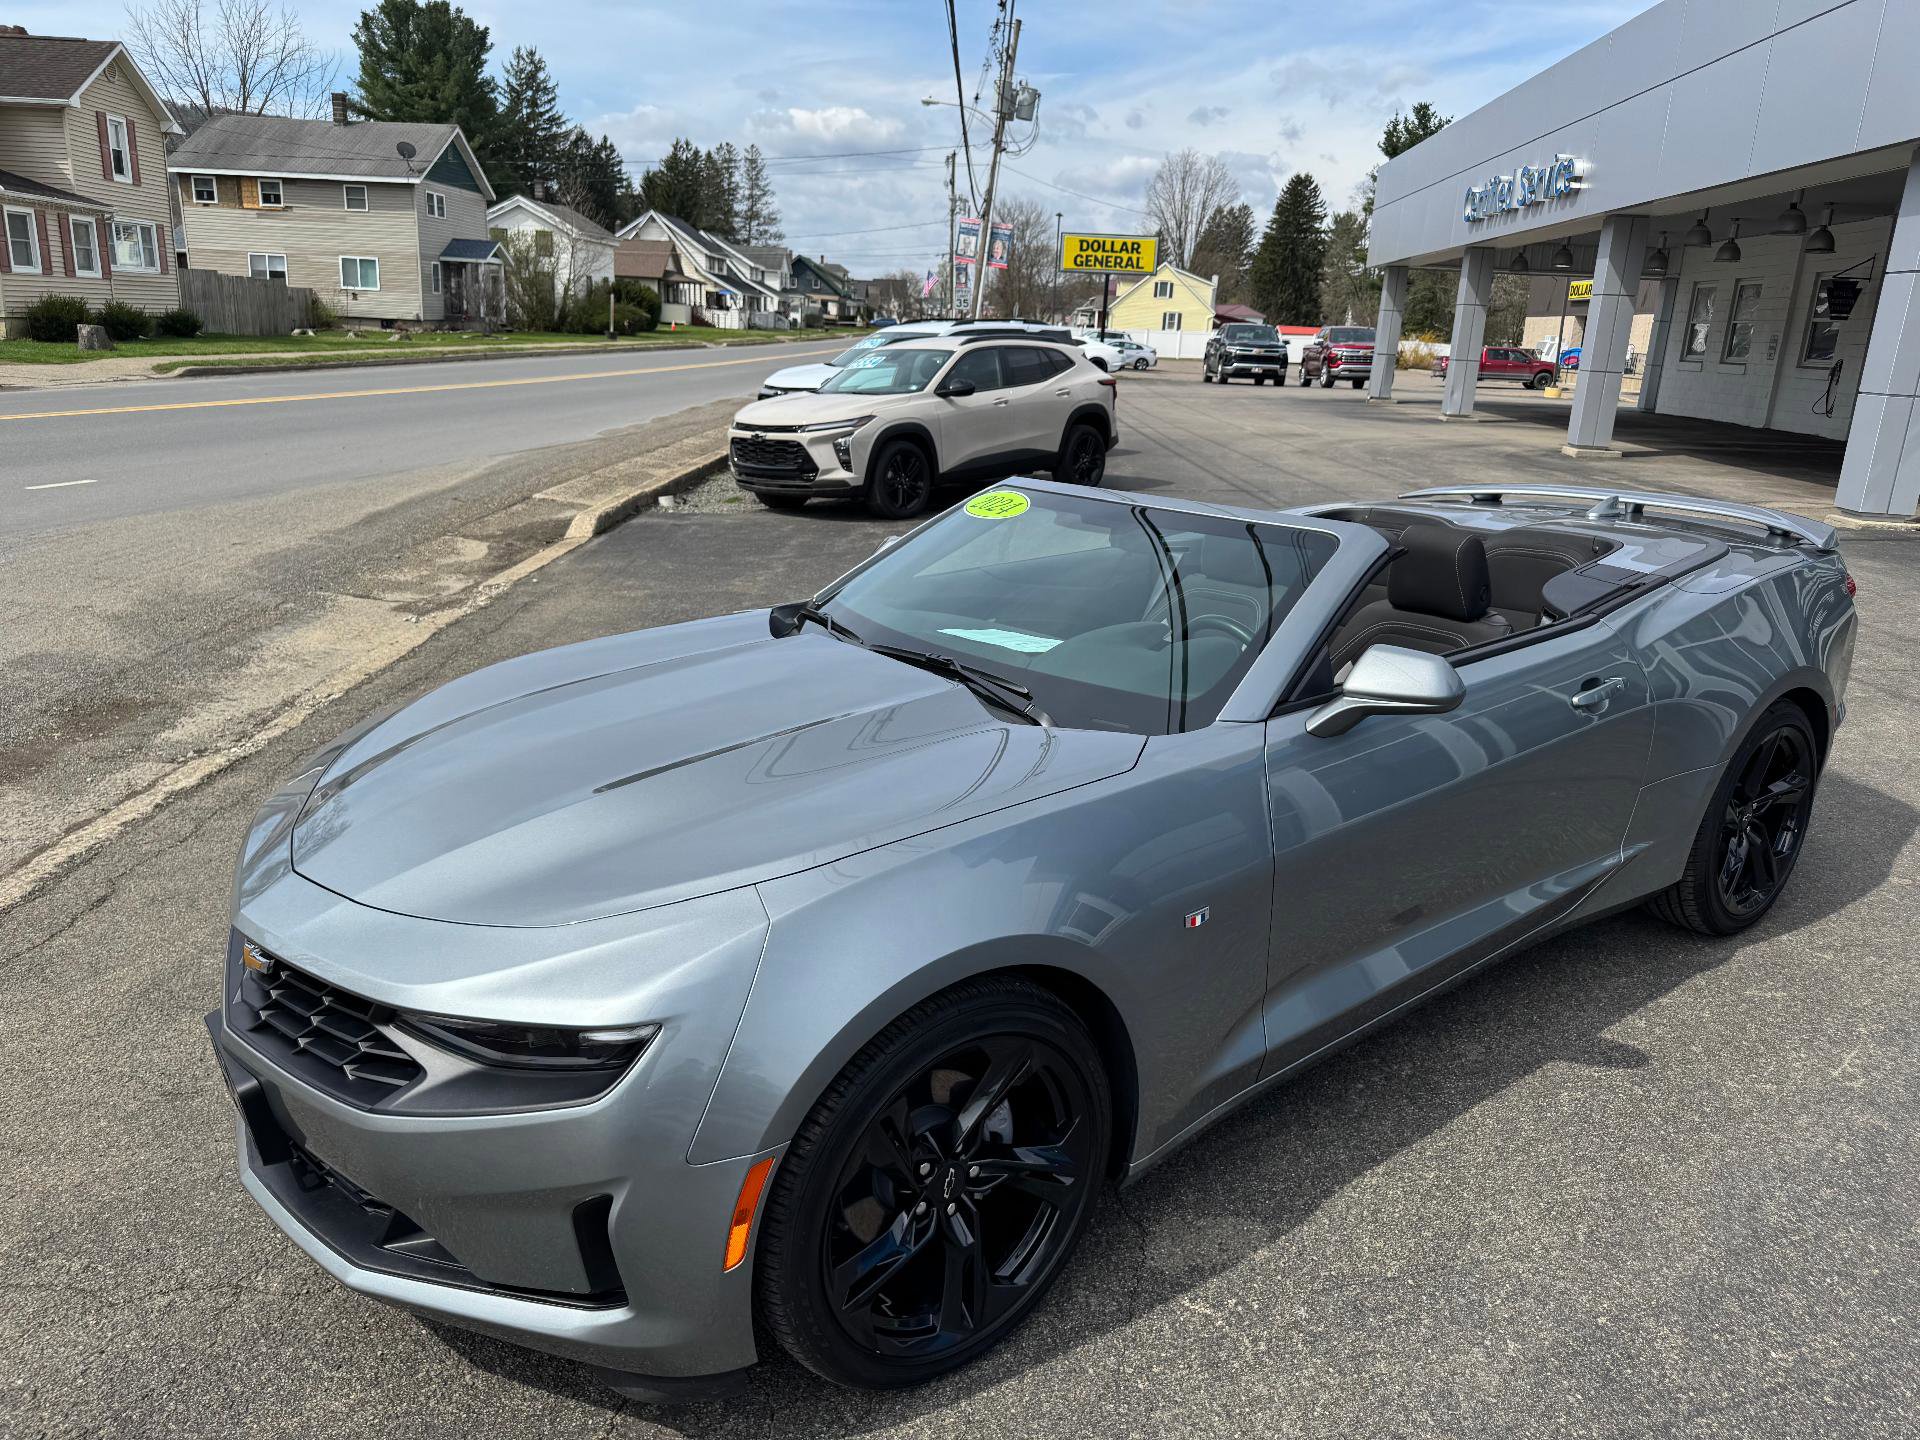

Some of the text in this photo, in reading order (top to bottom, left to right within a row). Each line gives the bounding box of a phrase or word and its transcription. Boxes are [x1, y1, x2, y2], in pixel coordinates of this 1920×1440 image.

[1517, 154, 1578, 207] Service
[1079, 239, 1141, 254] DOLLAR
[1073, 254, 1144, 269] GENERAL
[1570, 284, 1592, 296] DOLLAR
[956, 299, 969, 308] 35
